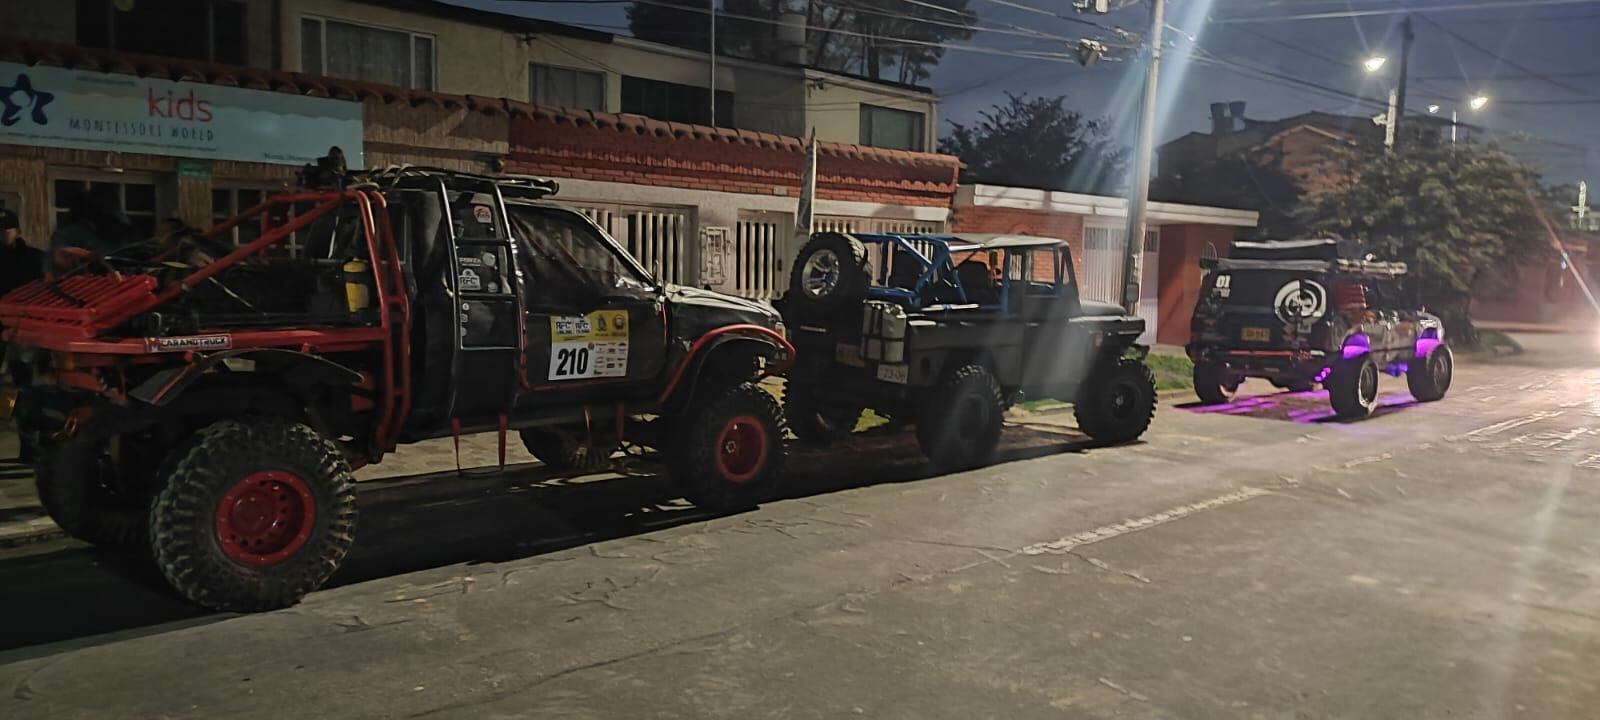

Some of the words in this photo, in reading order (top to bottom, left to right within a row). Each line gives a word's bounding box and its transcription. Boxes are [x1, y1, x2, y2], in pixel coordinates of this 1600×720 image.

[148, 88, 213, 123] kids
[1216, 275, 1231, 288] 01
[555, 347, 589, 377] 210
